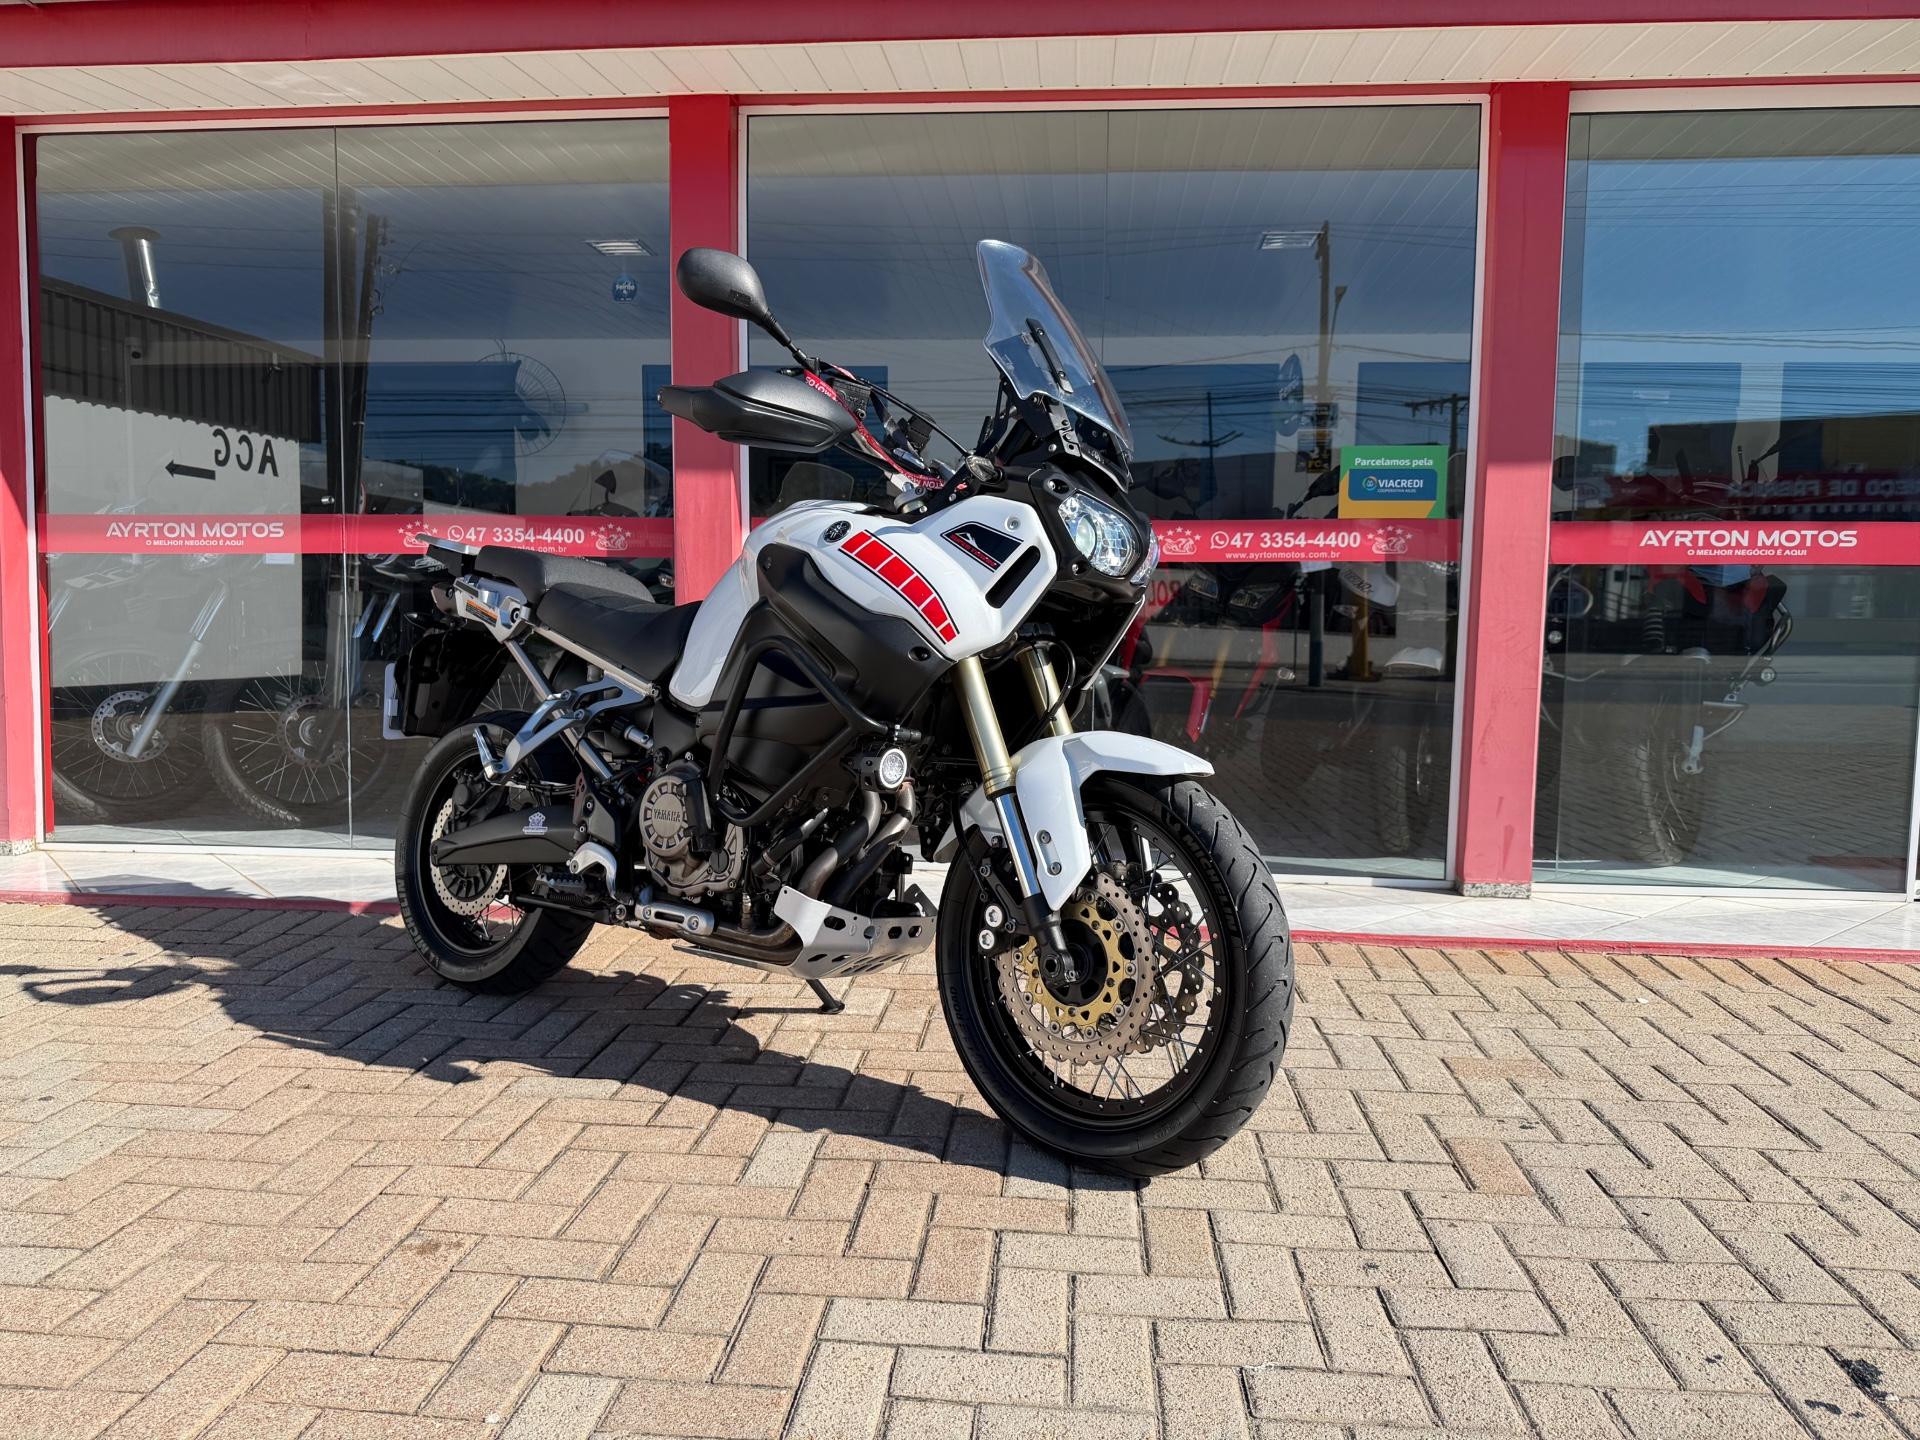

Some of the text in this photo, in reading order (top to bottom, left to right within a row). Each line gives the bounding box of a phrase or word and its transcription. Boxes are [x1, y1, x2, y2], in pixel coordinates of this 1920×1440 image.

[1354, 457, 1434, 467] Parcelamos pela
[1378, 479, 1424, 488] VIACREDI
[106, 522, 285, 538] AYRTON MOTOS
[465, 527, 585, 544] 47 3354-4400
[1230, 532, 1361, 548] 47 3354-4400
[1639, 529, 1858, 547] AYRTON MOTOS
[1225, 550, 1341, 561] www.ayrtonmotos.com.br
[1734, 548, 1776, 556] NEGÓCIO
[653, 807, 682, 822] YAMAHA
[397, 879, 430, 954] MICHELIN
